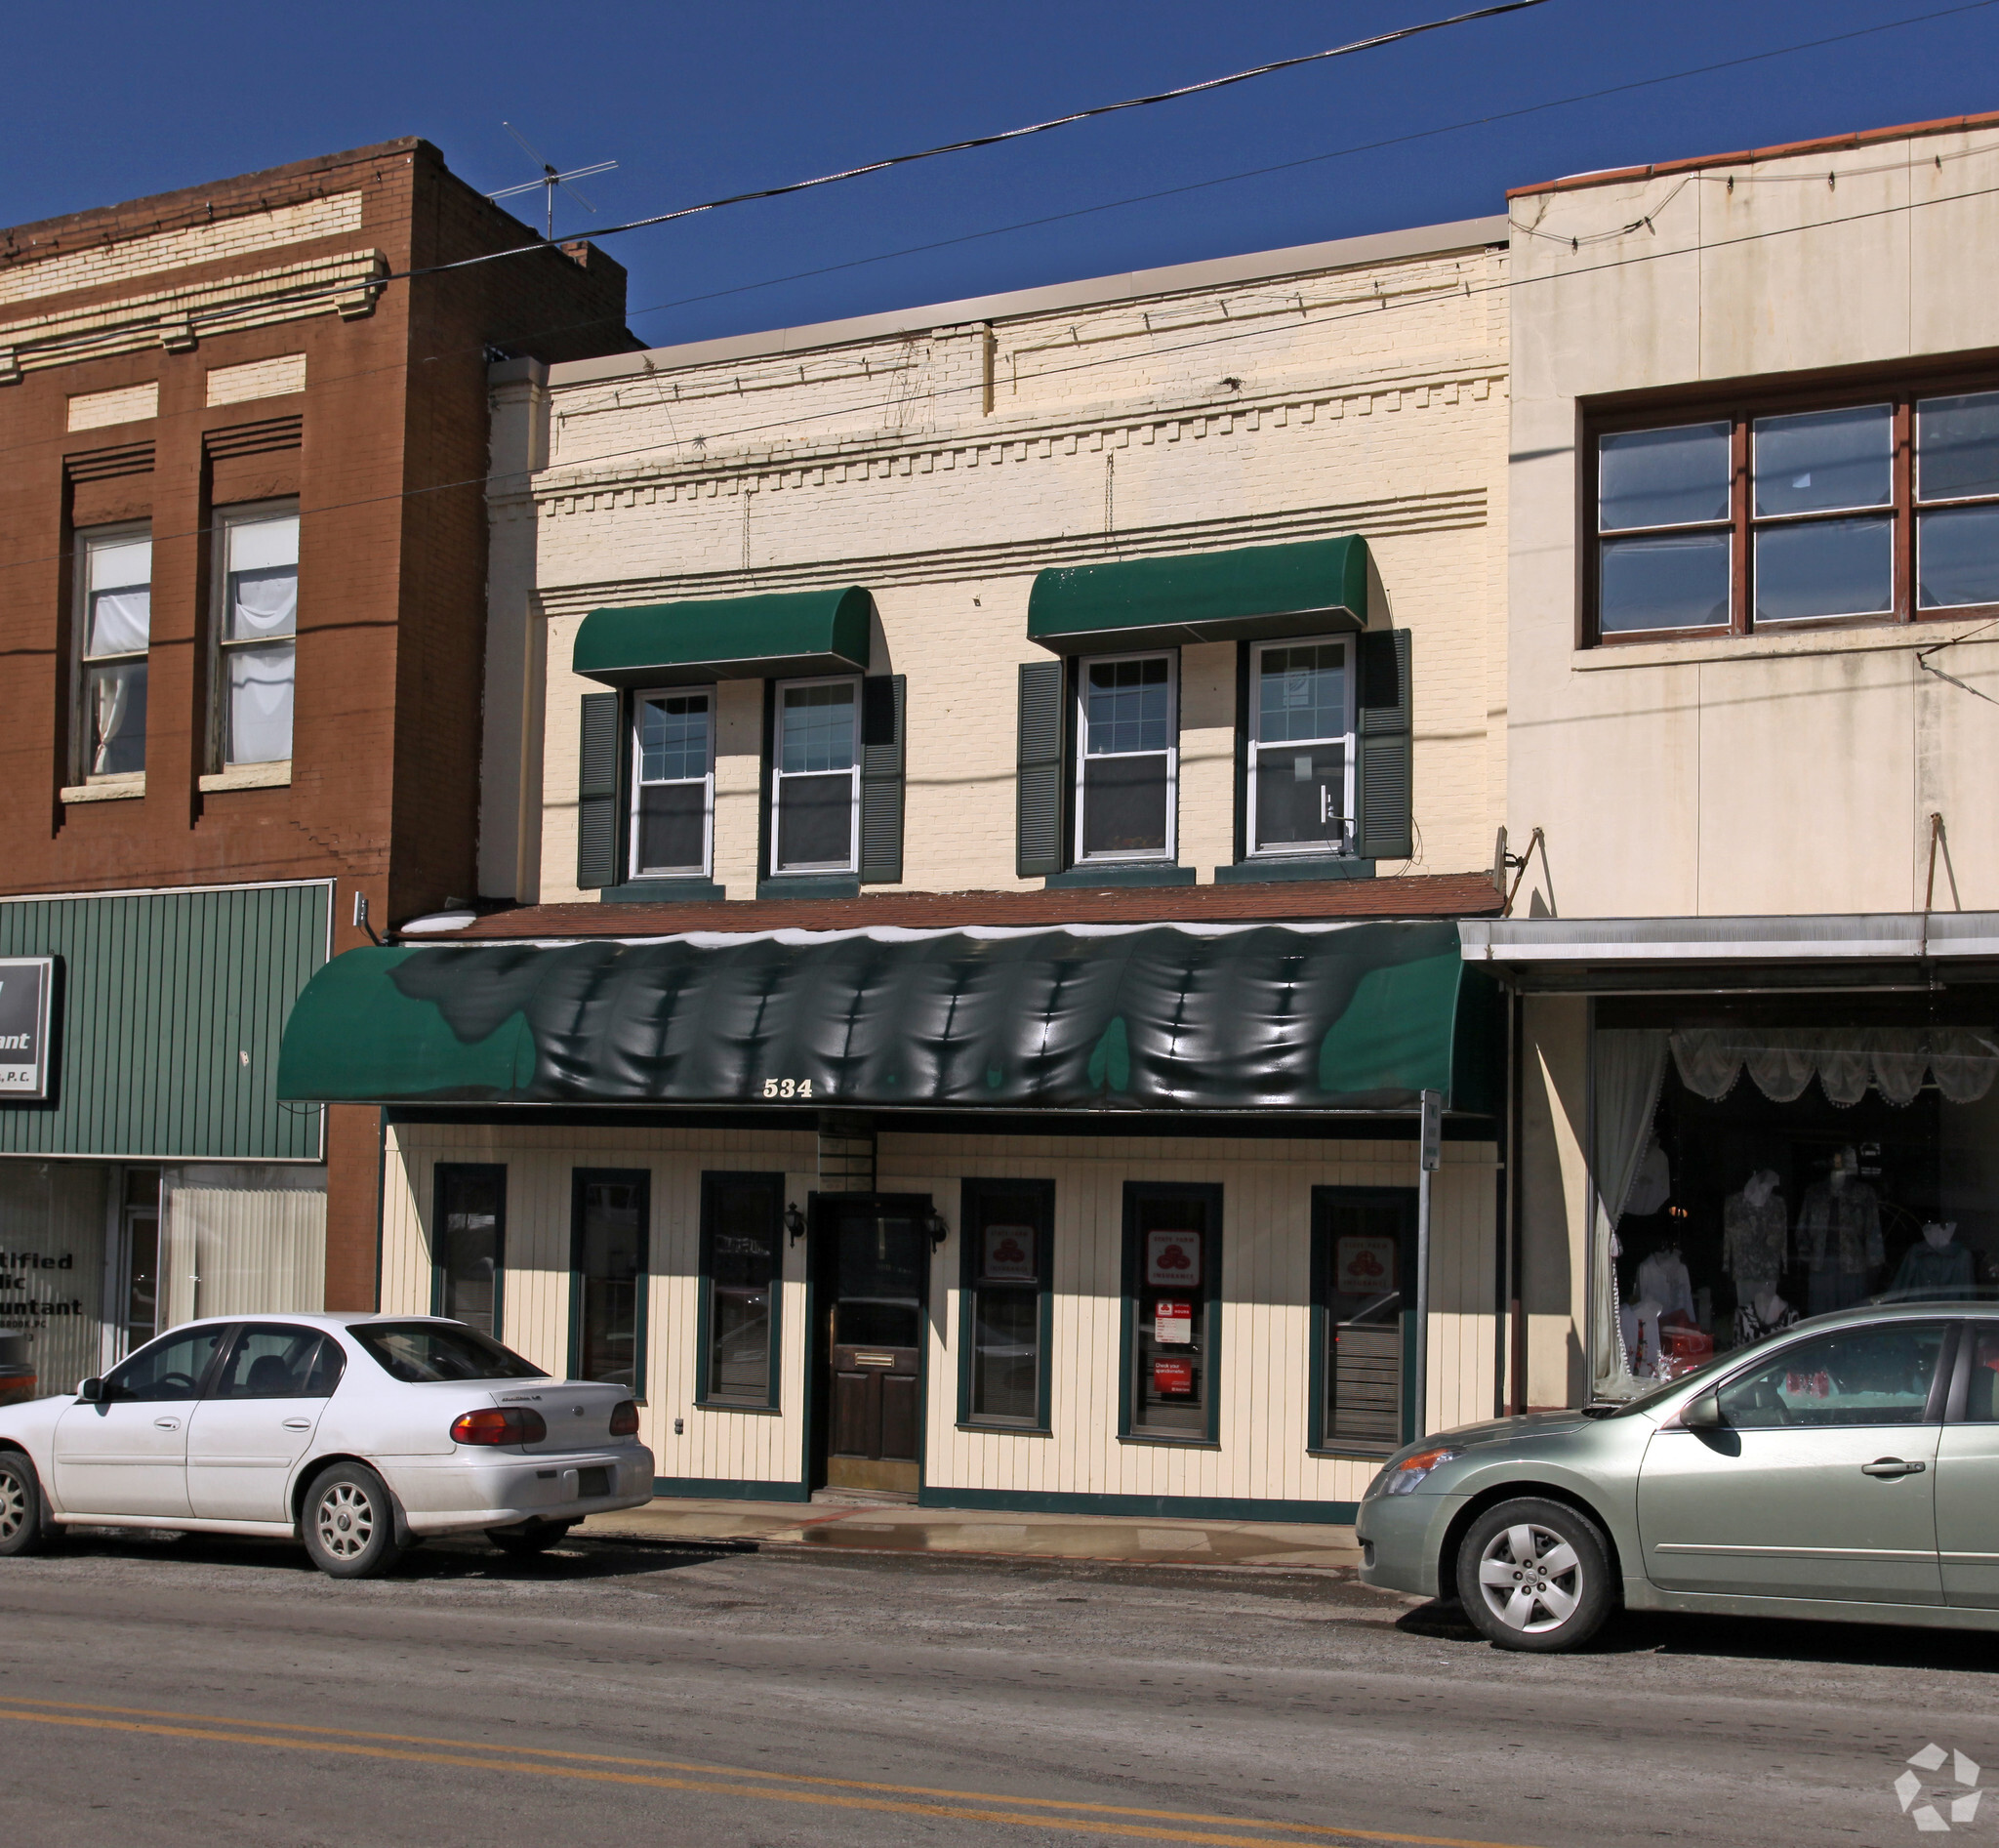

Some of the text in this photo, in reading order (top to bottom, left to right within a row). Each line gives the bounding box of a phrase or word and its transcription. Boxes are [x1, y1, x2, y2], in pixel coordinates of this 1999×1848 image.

[762, 1078, 813, 1098] 534
[0, 1253, 73, 1269] tified
[0, 1299, 83, 1315] untant
